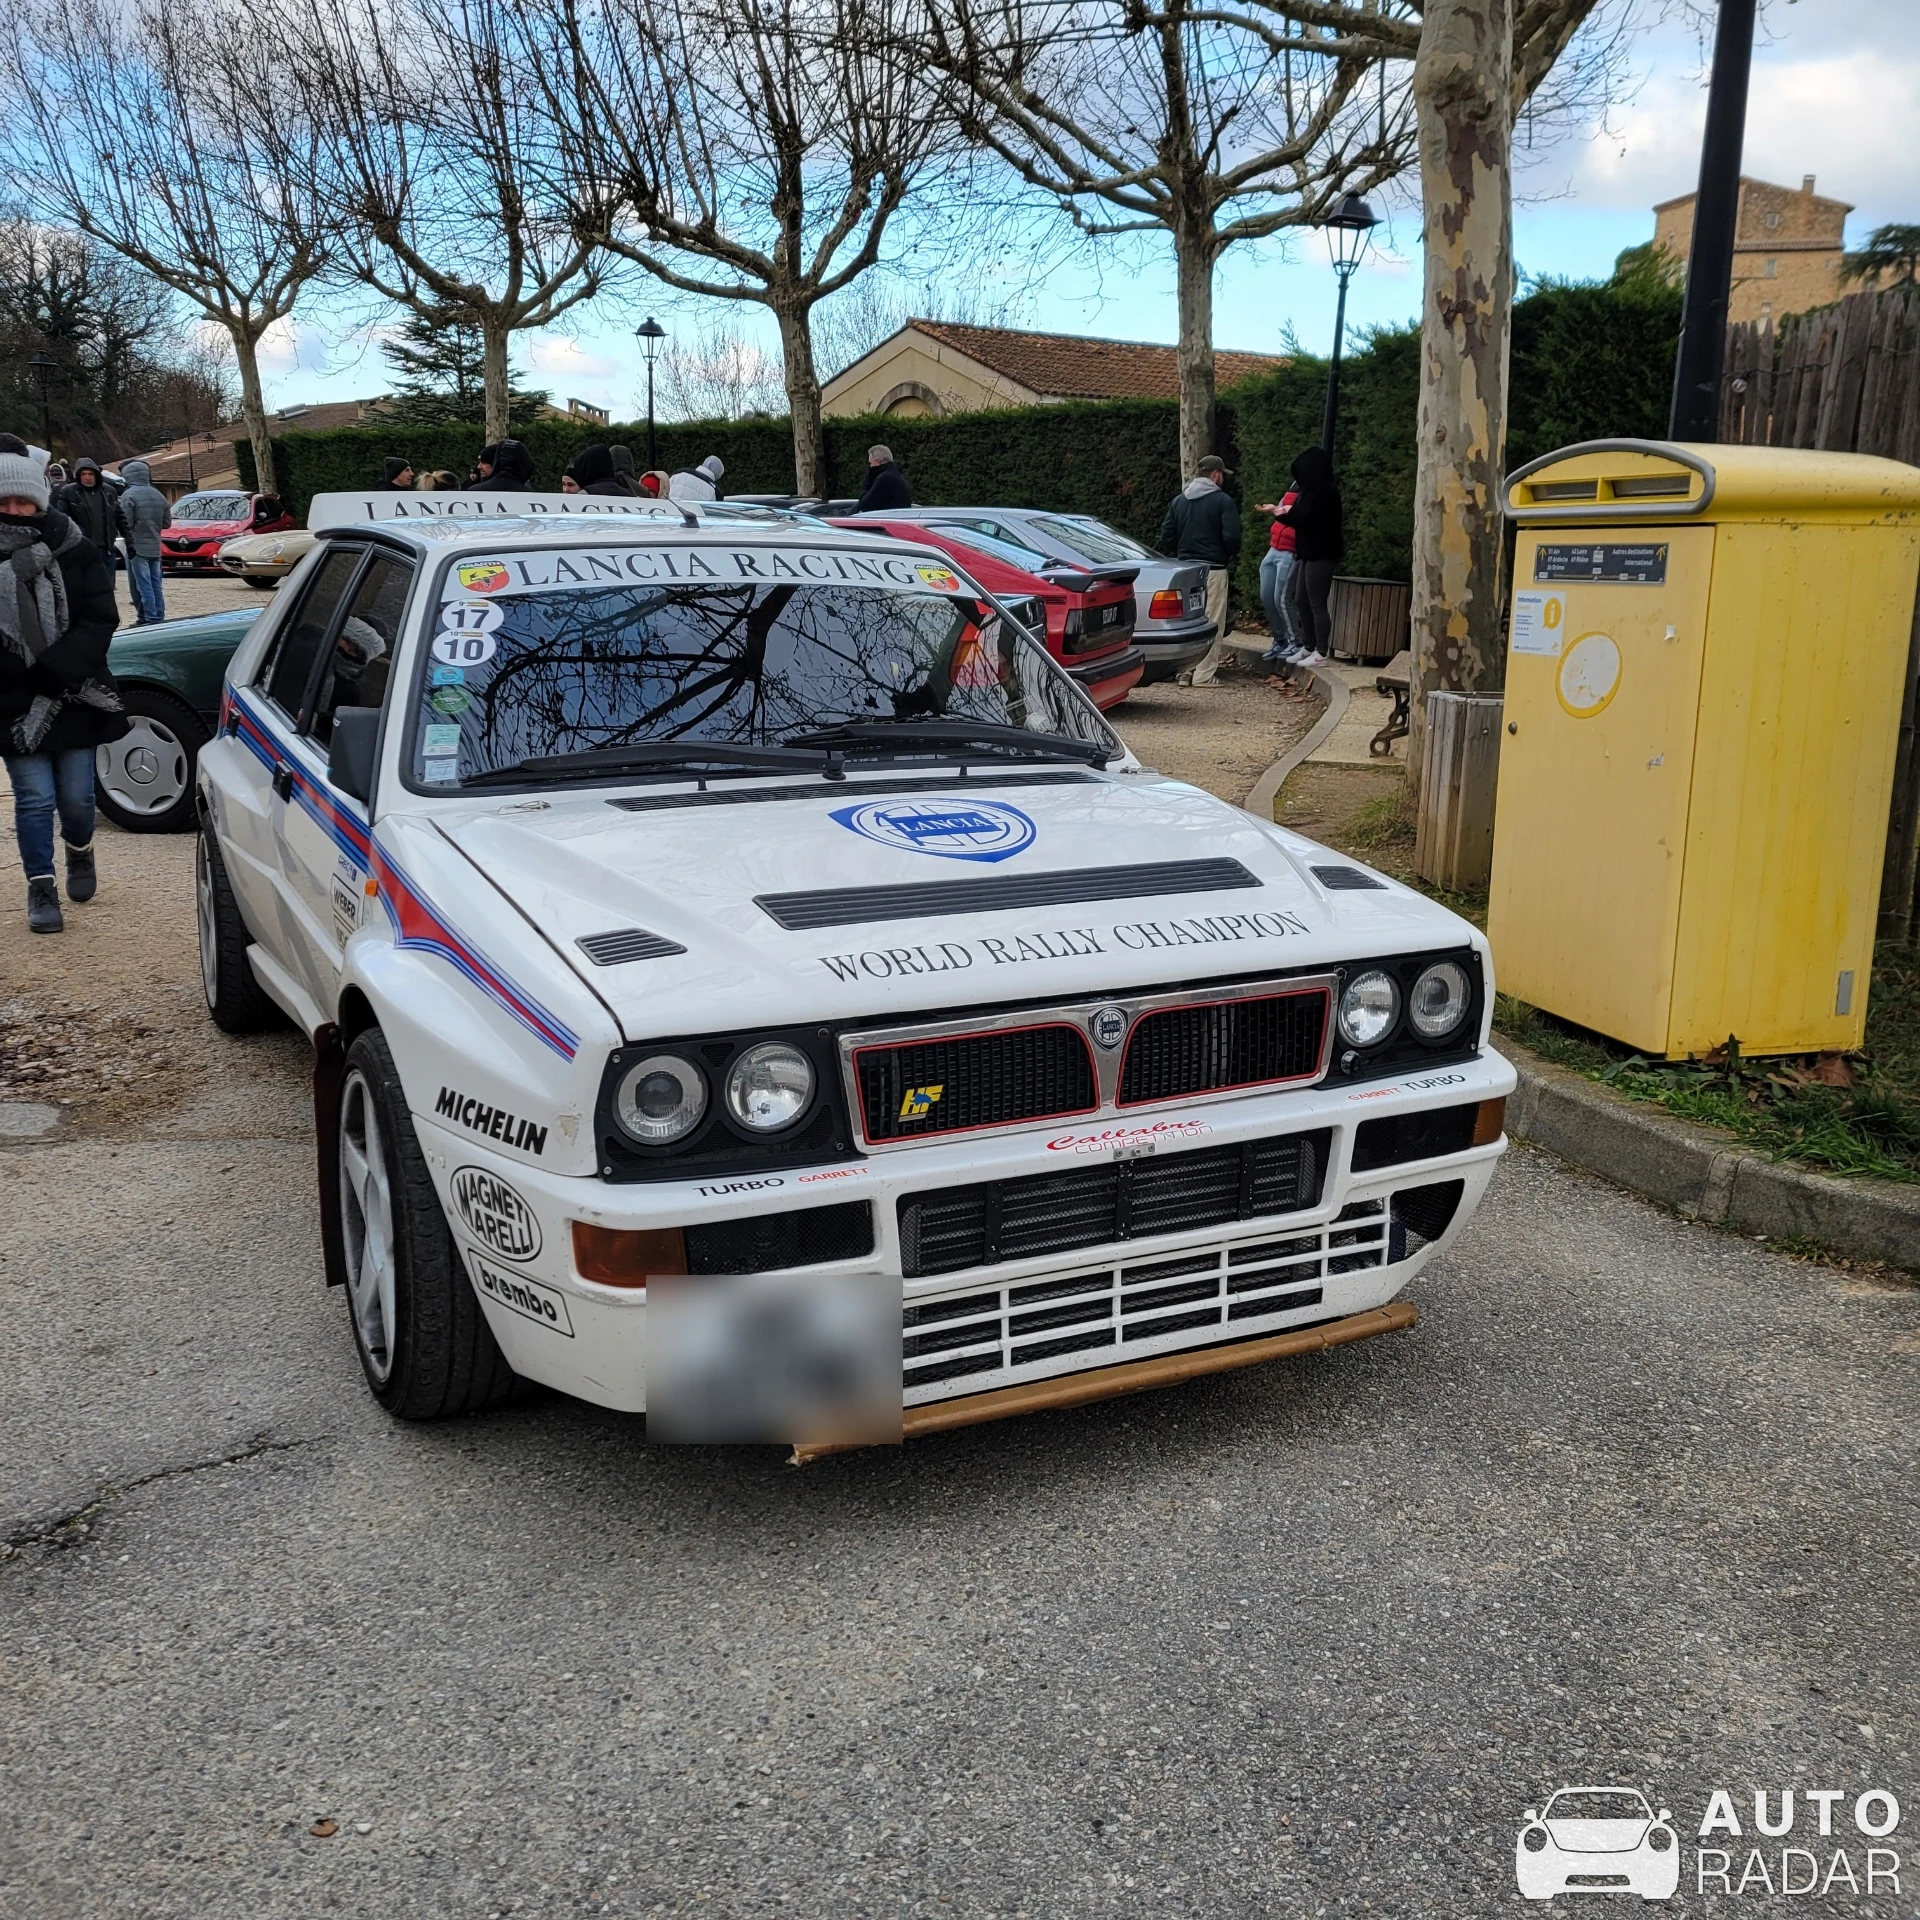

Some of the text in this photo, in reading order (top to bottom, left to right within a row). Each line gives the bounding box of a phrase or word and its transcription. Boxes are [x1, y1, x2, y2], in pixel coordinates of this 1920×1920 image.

[513, 551, 915, 586] LANCIA RACING
[451, 608, 489, 628] 17
[443, 639, 484, 660] 10
[896, 817, 991, 831] LANCIA
[333, 885, 356, 923] WEBER
[817, 911, 1312, 983] WORLD RALLY CHAMPION
[1102, 1023, 1121, 1031] LANCIA
[1348, 1074, 1466, 1101] GARRETT TURBO
[434, 1086, 549, 1156] MICHELIN
[692, 1167, 868, 1197] TURBO GARRETT
[456, 1172, 533, 1230] MAGNETI
[458, 1193, 534, 1255] MARELLI
[477, 1260, 558, 1322] brembo
